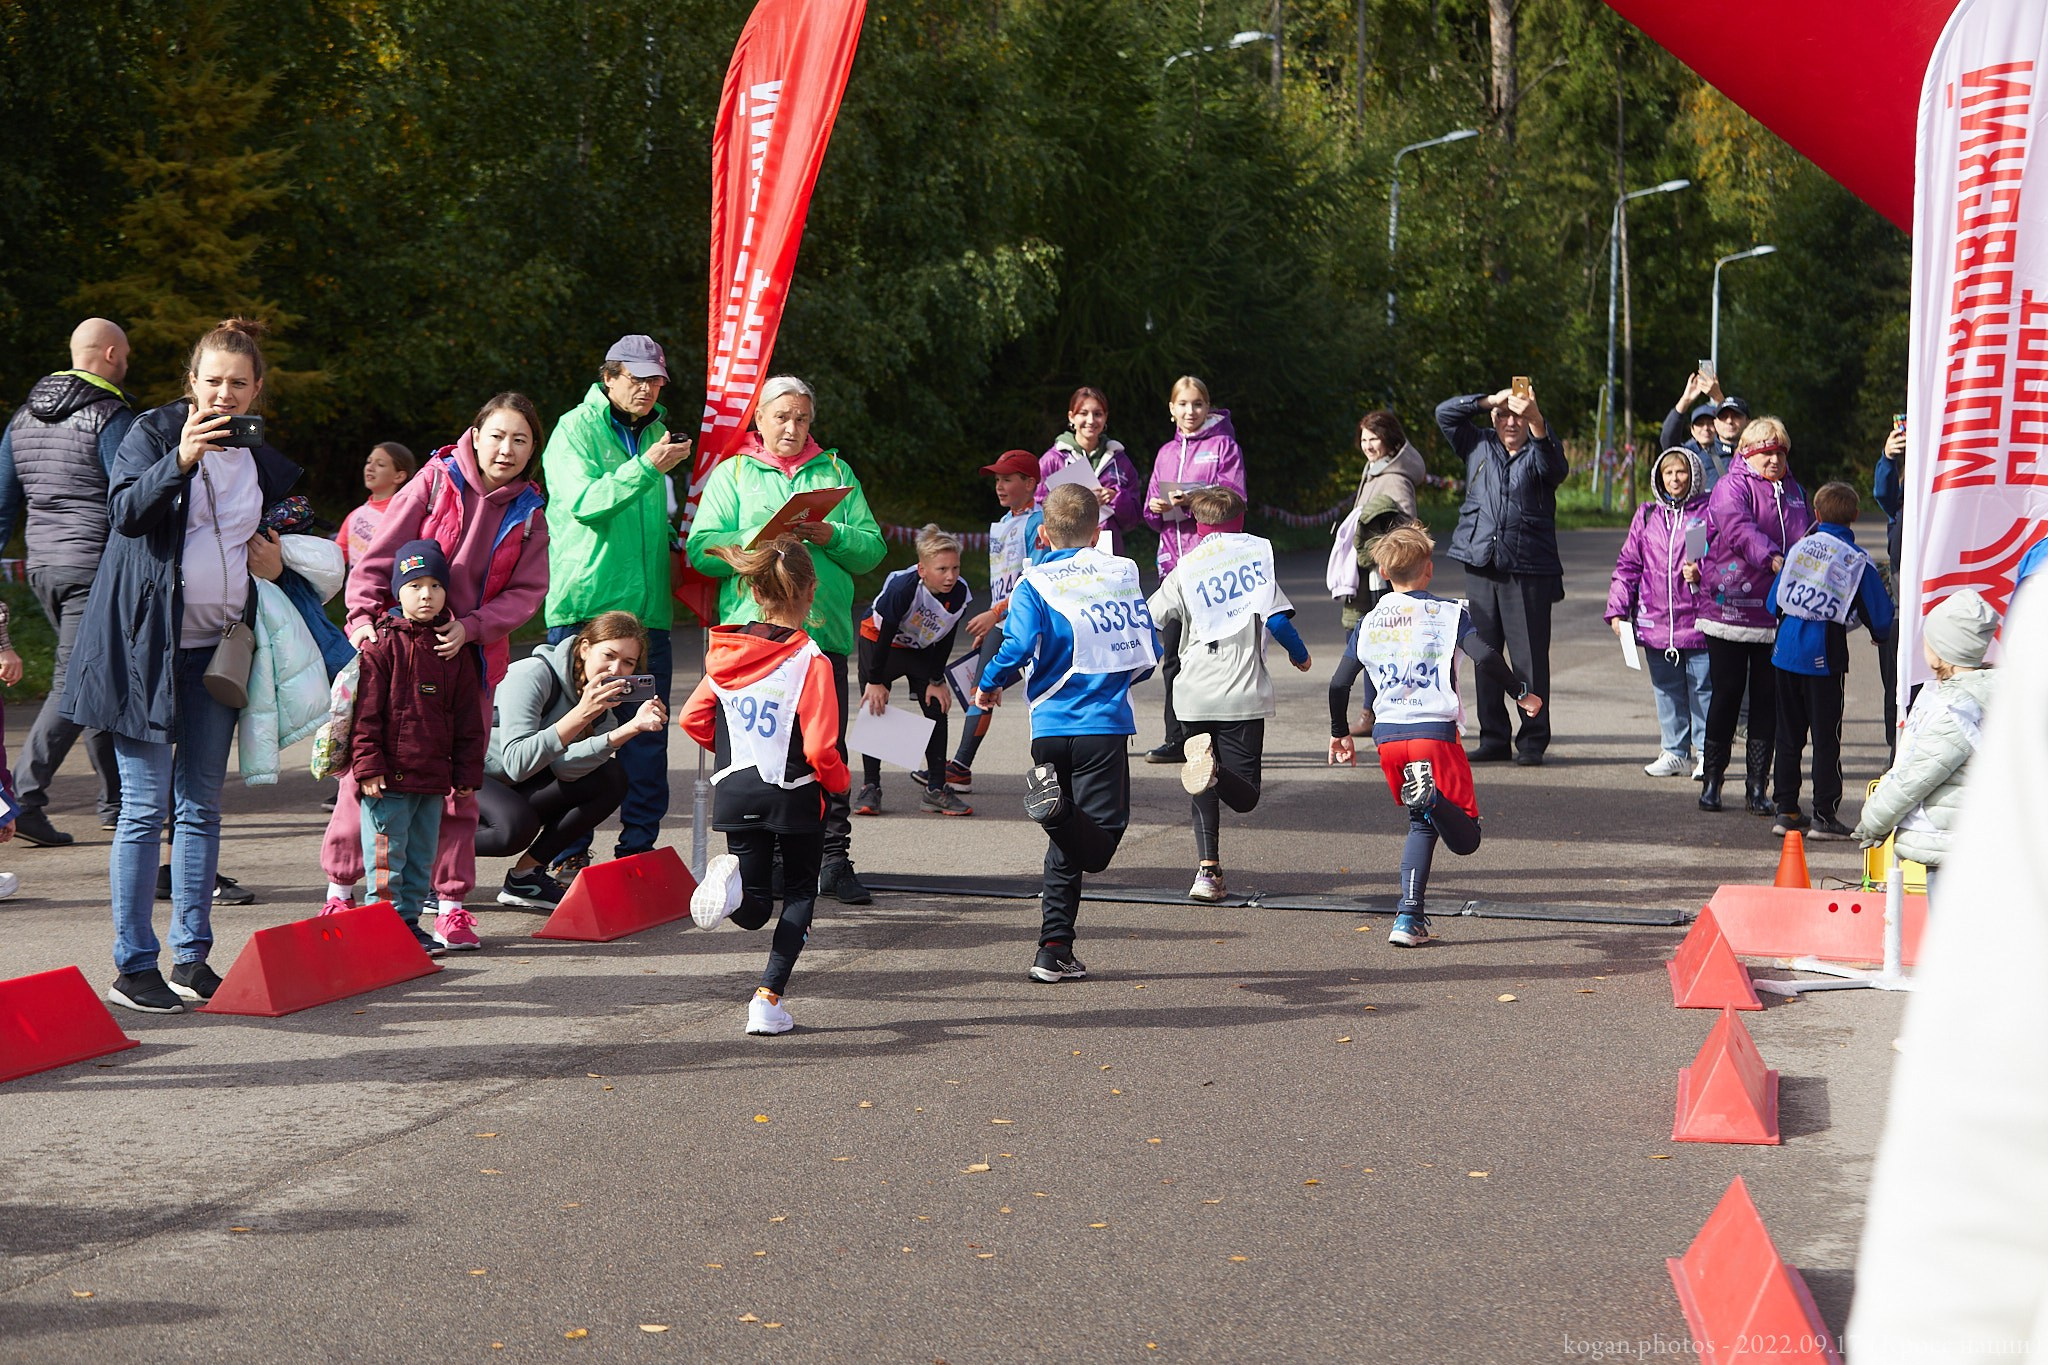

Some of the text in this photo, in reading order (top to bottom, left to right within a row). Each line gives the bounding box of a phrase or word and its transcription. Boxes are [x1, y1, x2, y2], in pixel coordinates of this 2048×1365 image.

[1931, 60, 2034, 494] МОСКОВСКИЙ
[1800, 546, 1833, 562] НАЦИИ
[1196, 560, 1267, 608] 13265
[1785, 580, 1841, 620] 13225
[1080, 598, 1152, 634] 13325
[1368, 616, 1412, 629] НАЦИИ
[1110, 638, 1142, 652] МОСКВА
[1390, 698, 1423, 708] МОСКВА
